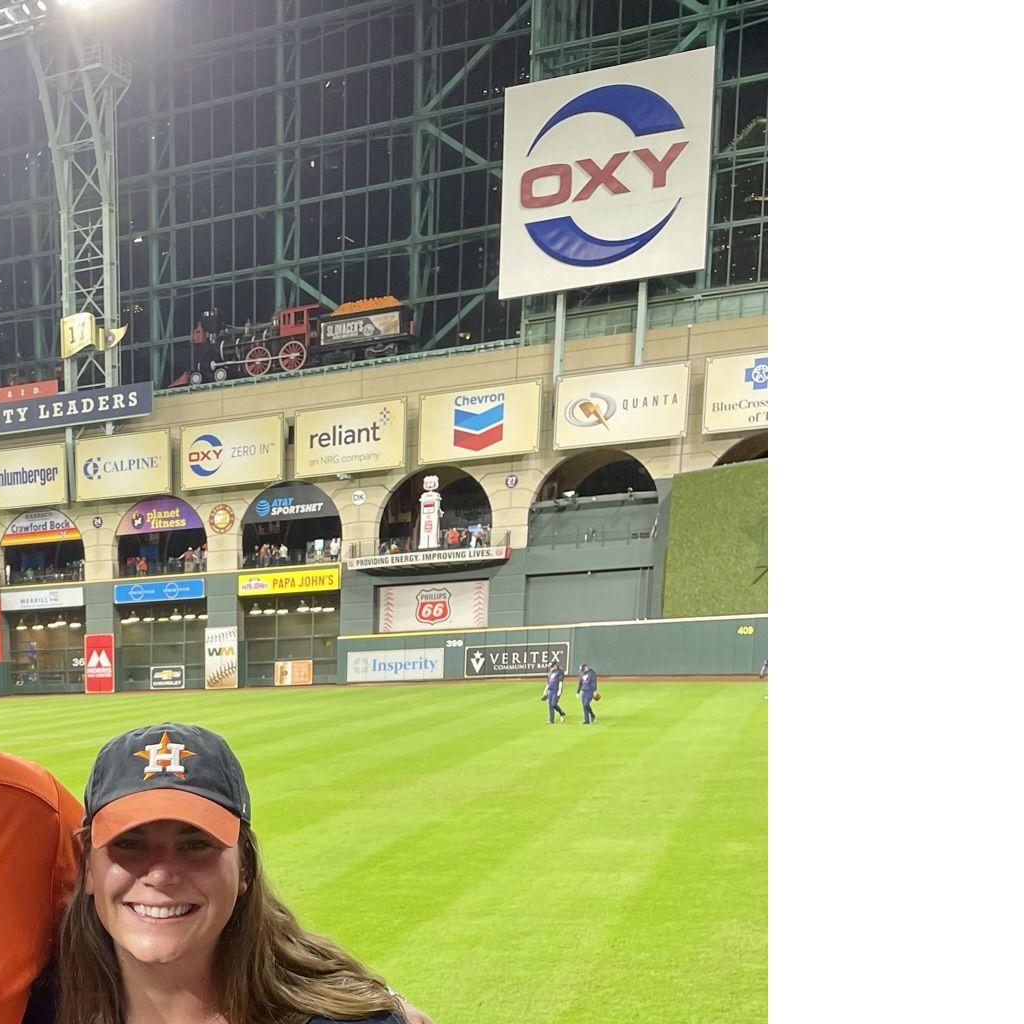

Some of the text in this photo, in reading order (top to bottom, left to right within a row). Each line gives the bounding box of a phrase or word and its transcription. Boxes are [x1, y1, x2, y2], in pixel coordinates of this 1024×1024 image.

[520, 140, 690, 209] OXY
[38, 391, 138, 420] LEADERS
[454, 390, 505, 407] Chevron
[622, 392, 679, 411] QUANTA
[309, 421, 381, 449] reliant
[188, 448, 224, 463] OXY
[230, 444, 257, 459] ZERO
[308, 451, 380, 467] an NRG company
[103, 456, 159, 474] CALPINE
[270, 502, 324, 516] SPORTSNET
[271, 497, 294, 507] AT&T
[146, 507, 180, 521] planet
[10, 519, 71, 534] Crawford Bock
[151, 516, 187, 529] fitness
[356, 549, 494, 567] PROVIDING ENERGY. IMPROVING LIVES.
[272, 574, 334, 589] PAPA JOHN'S
[420, 592, 447, 601] PHILLIPS
[421, 605, 444, 618] 66
[446, 639, 463, 648] 399
[207, 647, 234, 656] WM
[489, 650, 560, 665] VERITEX
[371, 656, 438, 675] Insperity
[493, 663, 536, 671] COMMUNITY
